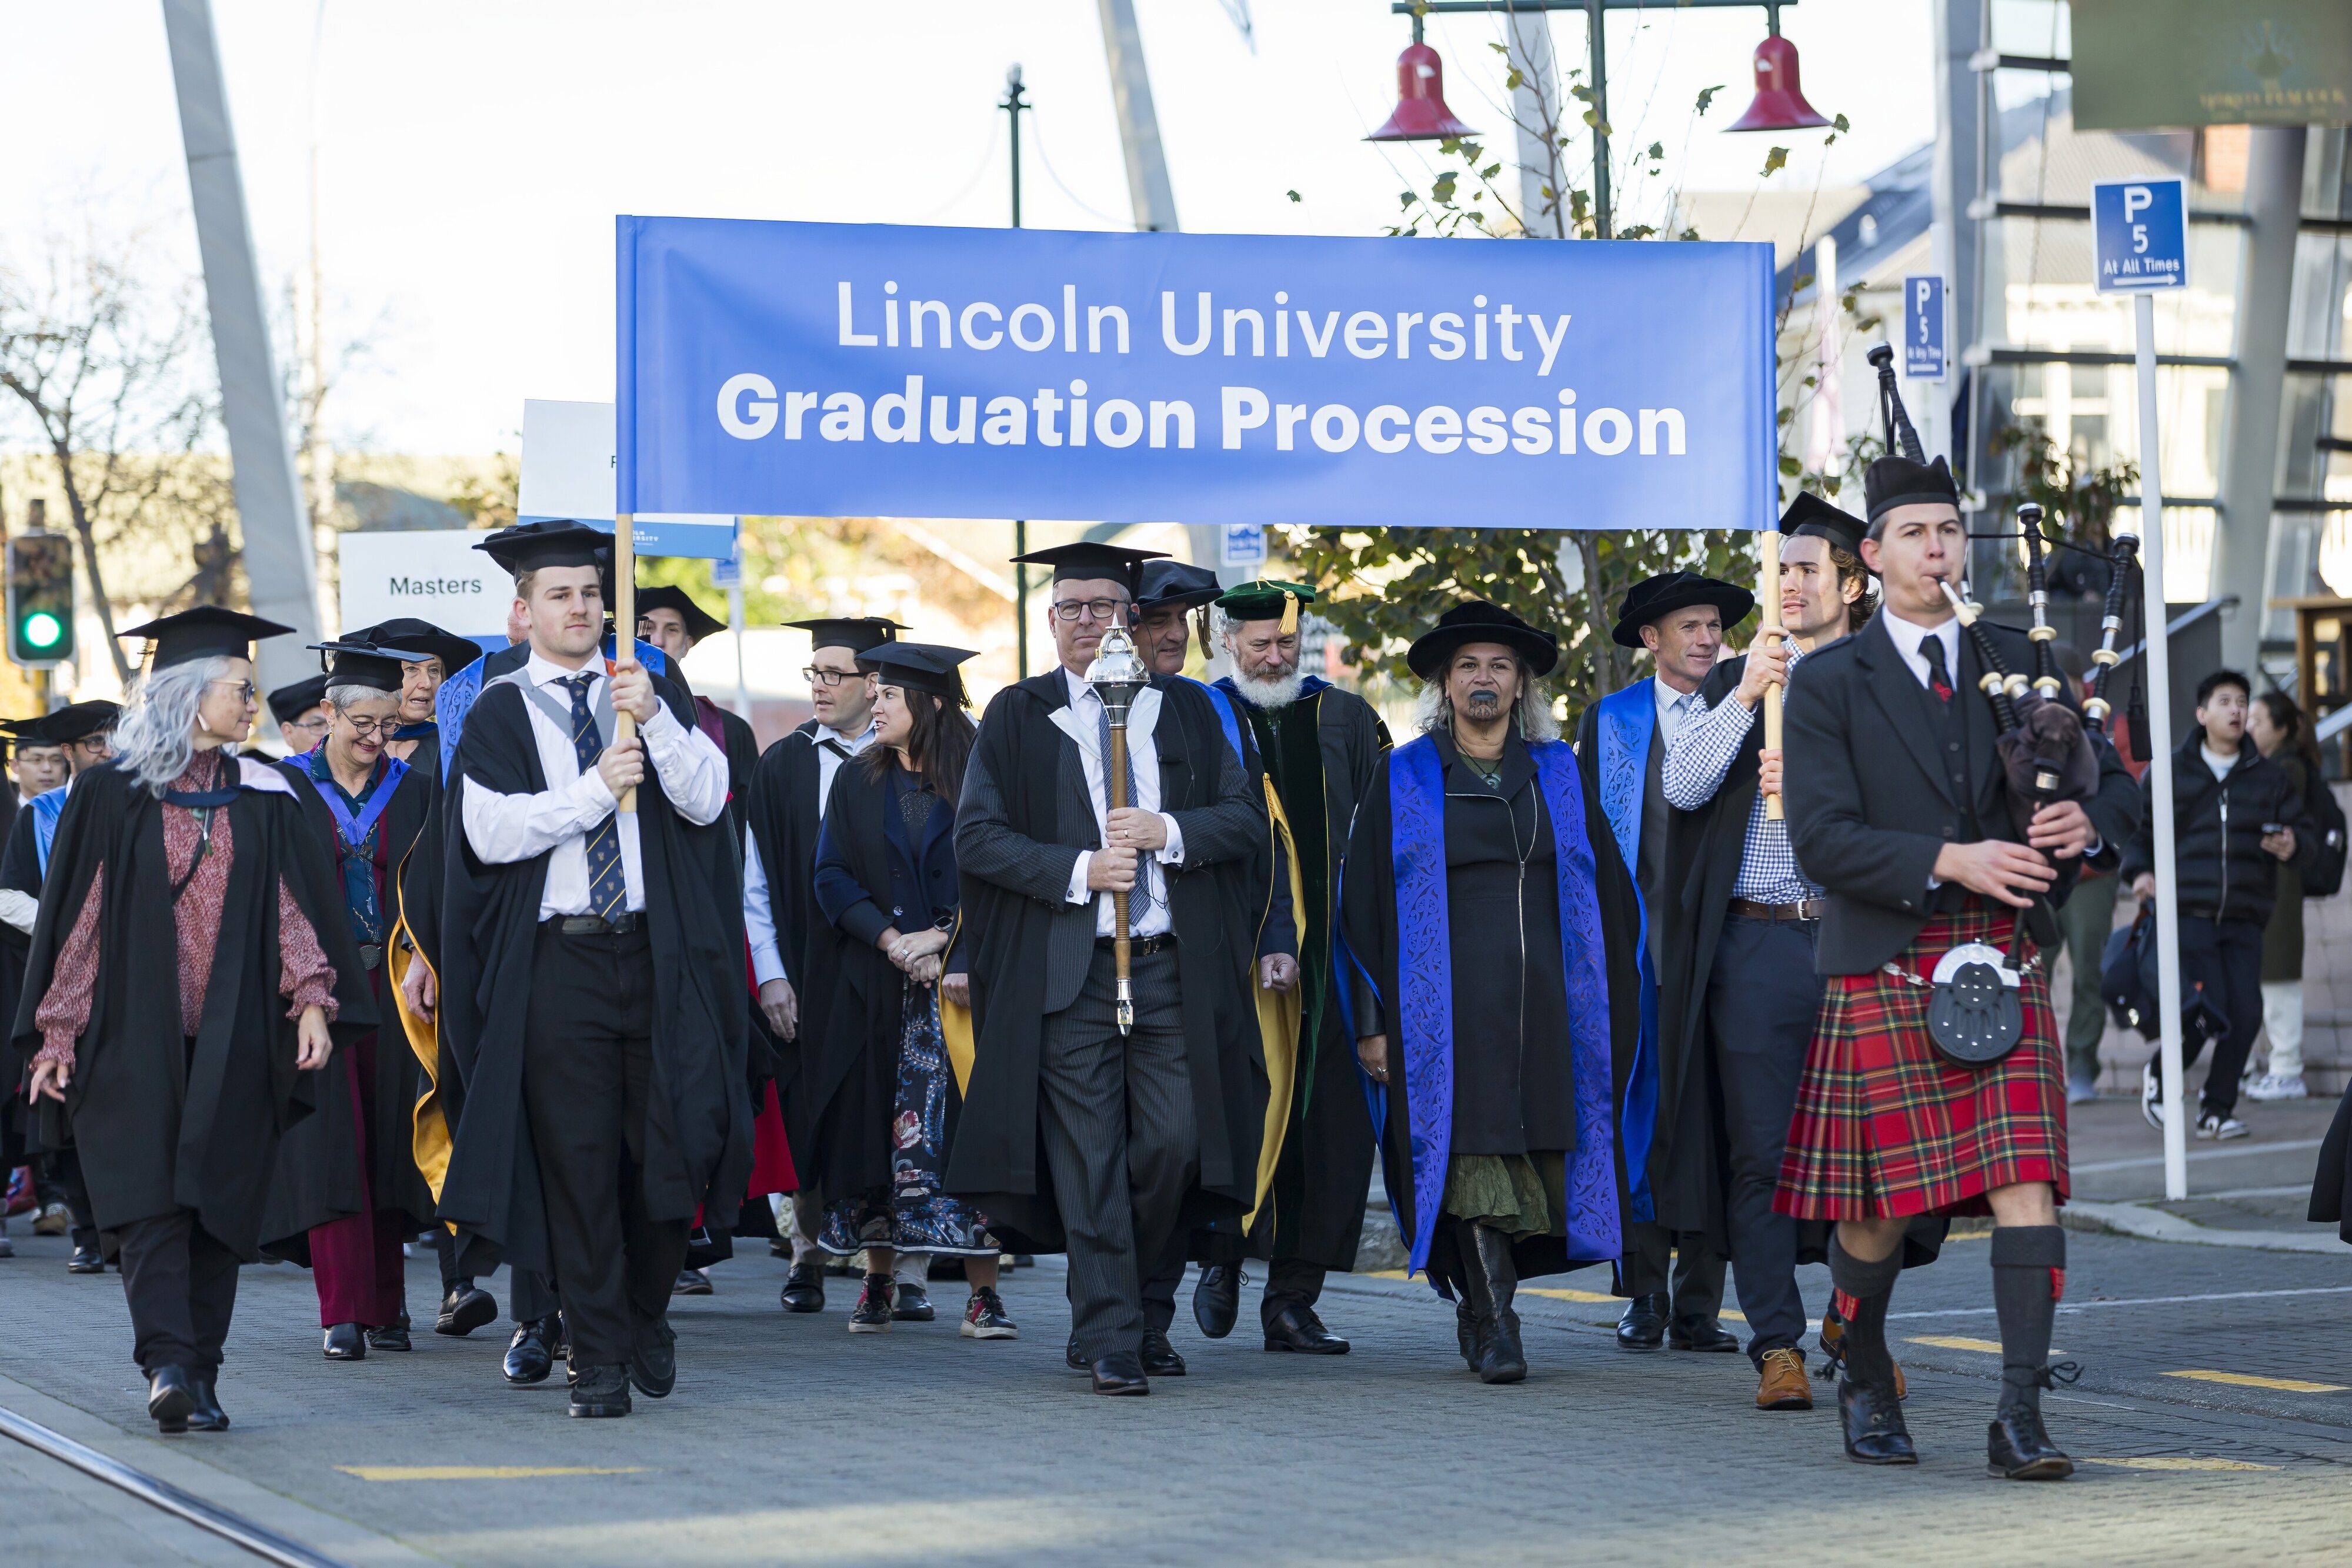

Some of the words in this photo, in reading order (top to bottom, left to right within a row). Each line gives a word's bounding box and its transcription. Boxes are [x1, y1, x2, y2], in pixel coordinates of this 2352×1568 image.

[2124, 186, 2153, 223] P
[2133, 224, 2149, 253] 5
[2103, 258, 2119, 275] At
[2122, 258, 2140, 274] All
[2143, 257, 2180, 273] Times
[1916, 279, 1931, 315] P
[838, 281, 1130, 353] Lincoln
[1162, 291, 1572, 376] University
[1919, 316, 1929, 344] 5
[716, 373, 1196, 449] Graduation
[1221, 386, 1687, 457] Procession
[389, 576, 482, 595] Masters
